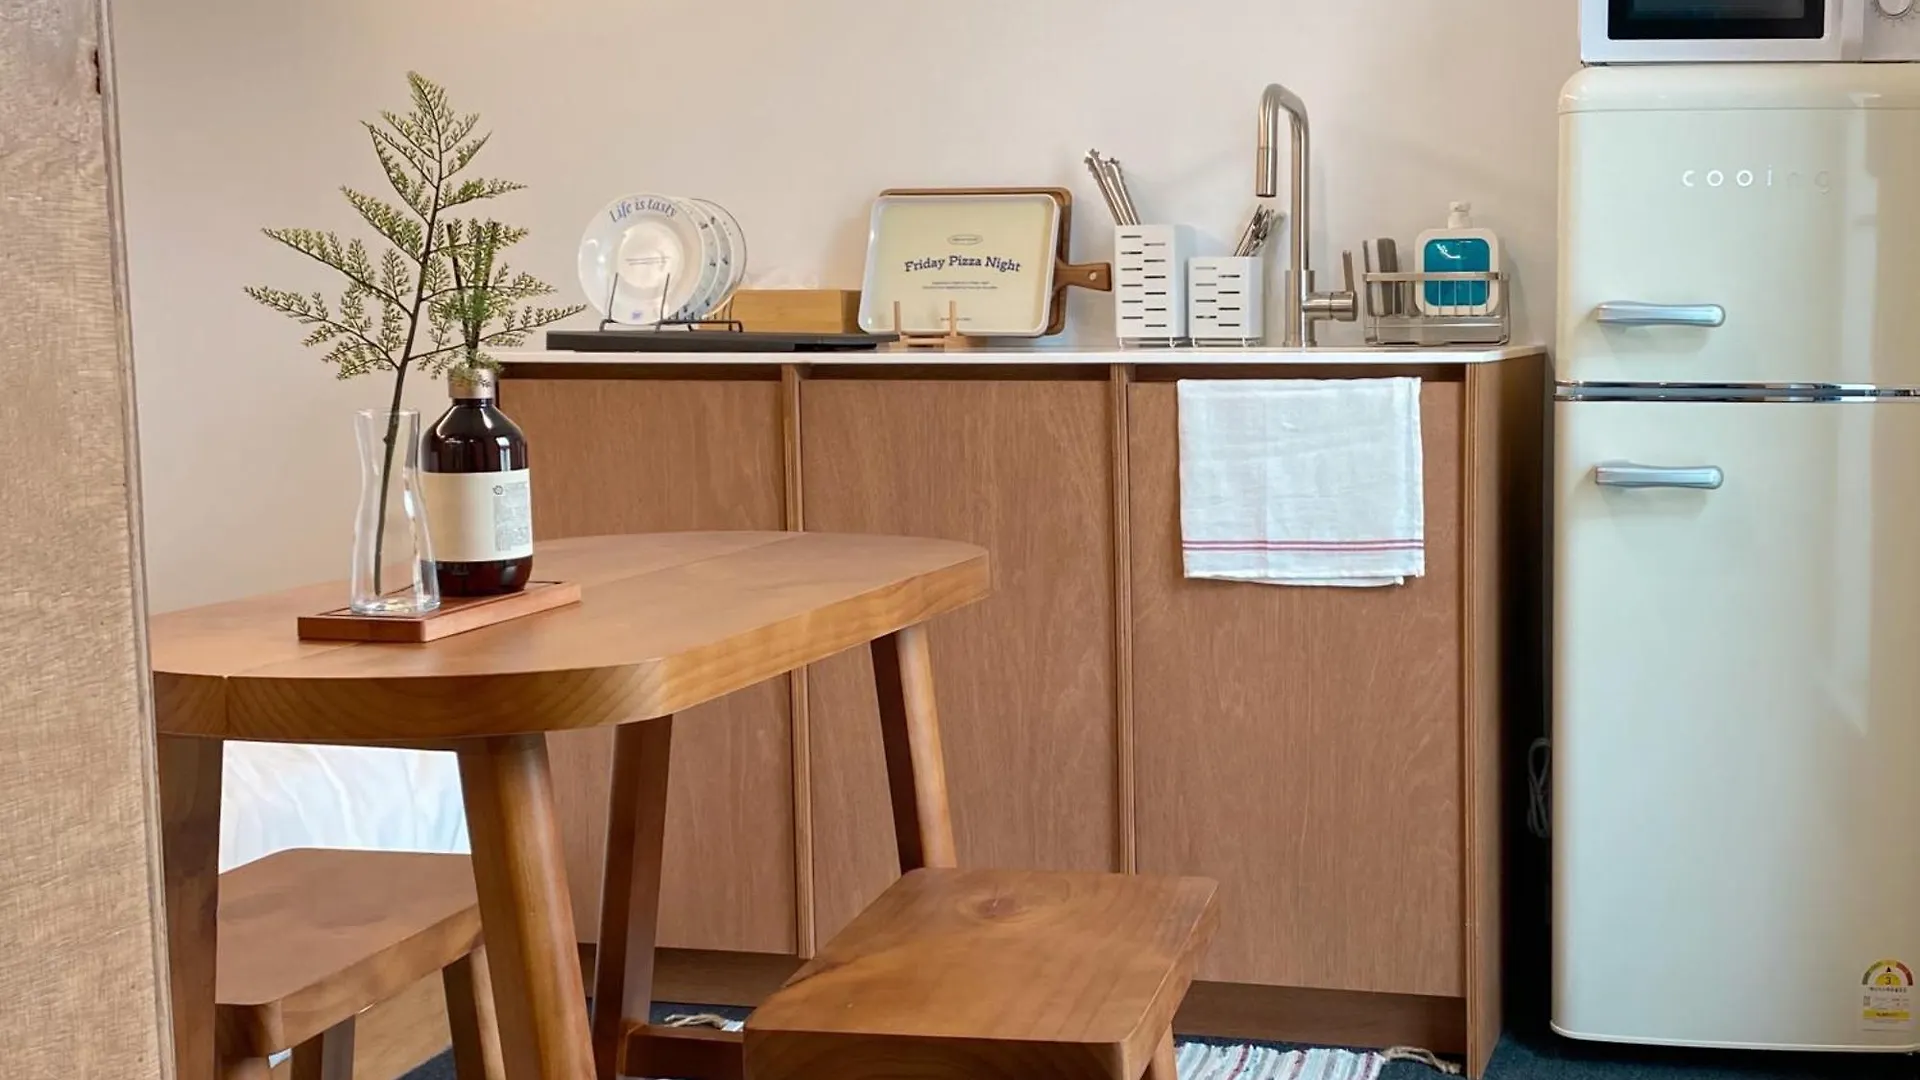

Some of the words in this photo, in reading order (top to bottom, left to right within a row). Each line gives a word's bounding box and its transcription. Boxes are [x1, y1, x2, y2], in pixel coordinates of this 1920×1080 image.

[609, 202, 632, 223] Life
[635, 198, 646, 211] is
[648, 199, 678, 217] tasty
[904, 257, 946, 272] Friday
[949, 255, 982, 267] Pizza
[985, 256, 1021, 273] Night
[1884, 976, 1892, 985] 3
